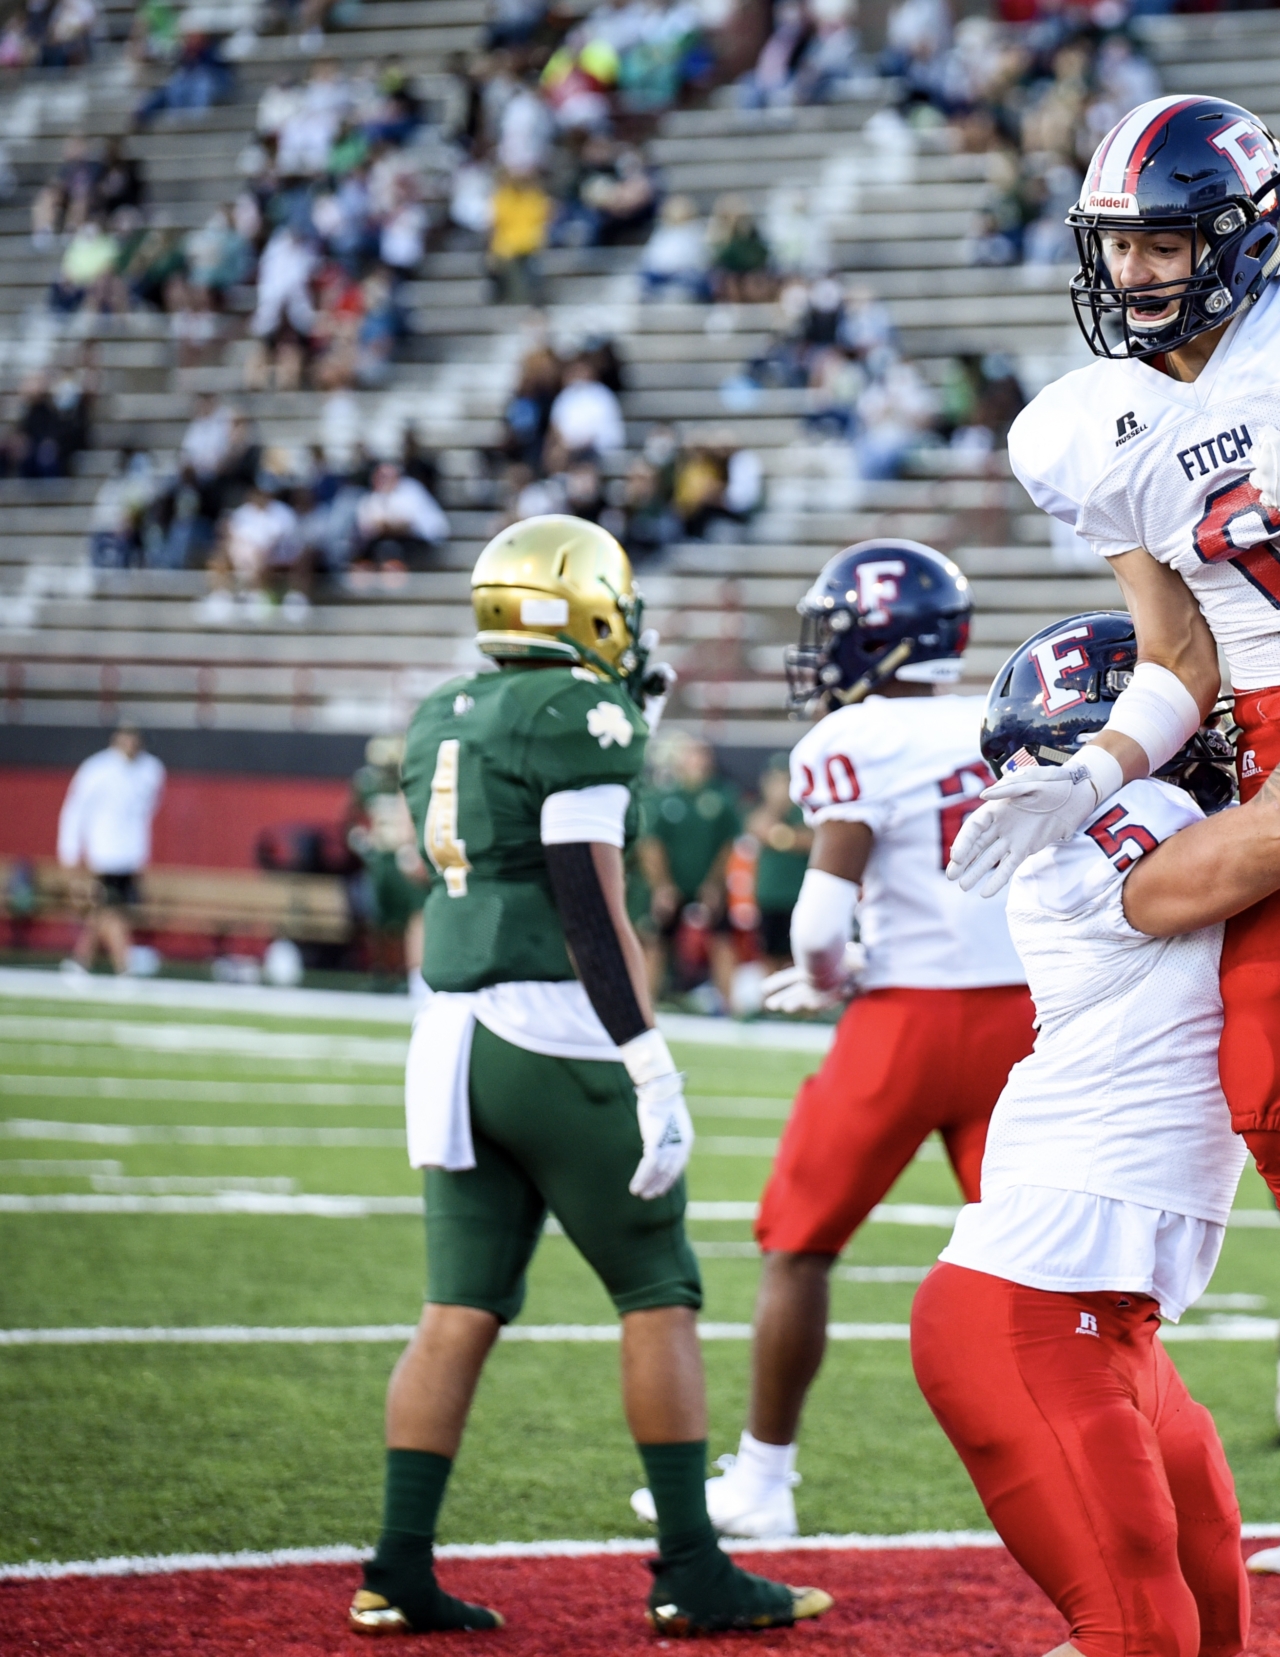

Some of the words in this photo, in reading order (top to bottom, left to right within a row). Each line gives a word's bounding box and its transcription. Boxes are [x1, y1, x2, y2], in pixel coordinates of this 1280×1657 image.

[1089, 195, 1130, 209] Riddell
[1206, 117, 1279, 217] F
[1115, 423, 1149, 448] RUSSELL
[1176, 424, 1254, 482] FITCH
[855, 559, 907, 629] F
[1027, 623, 1096, 718] F
[1083, 803, 1160, 873] 5
